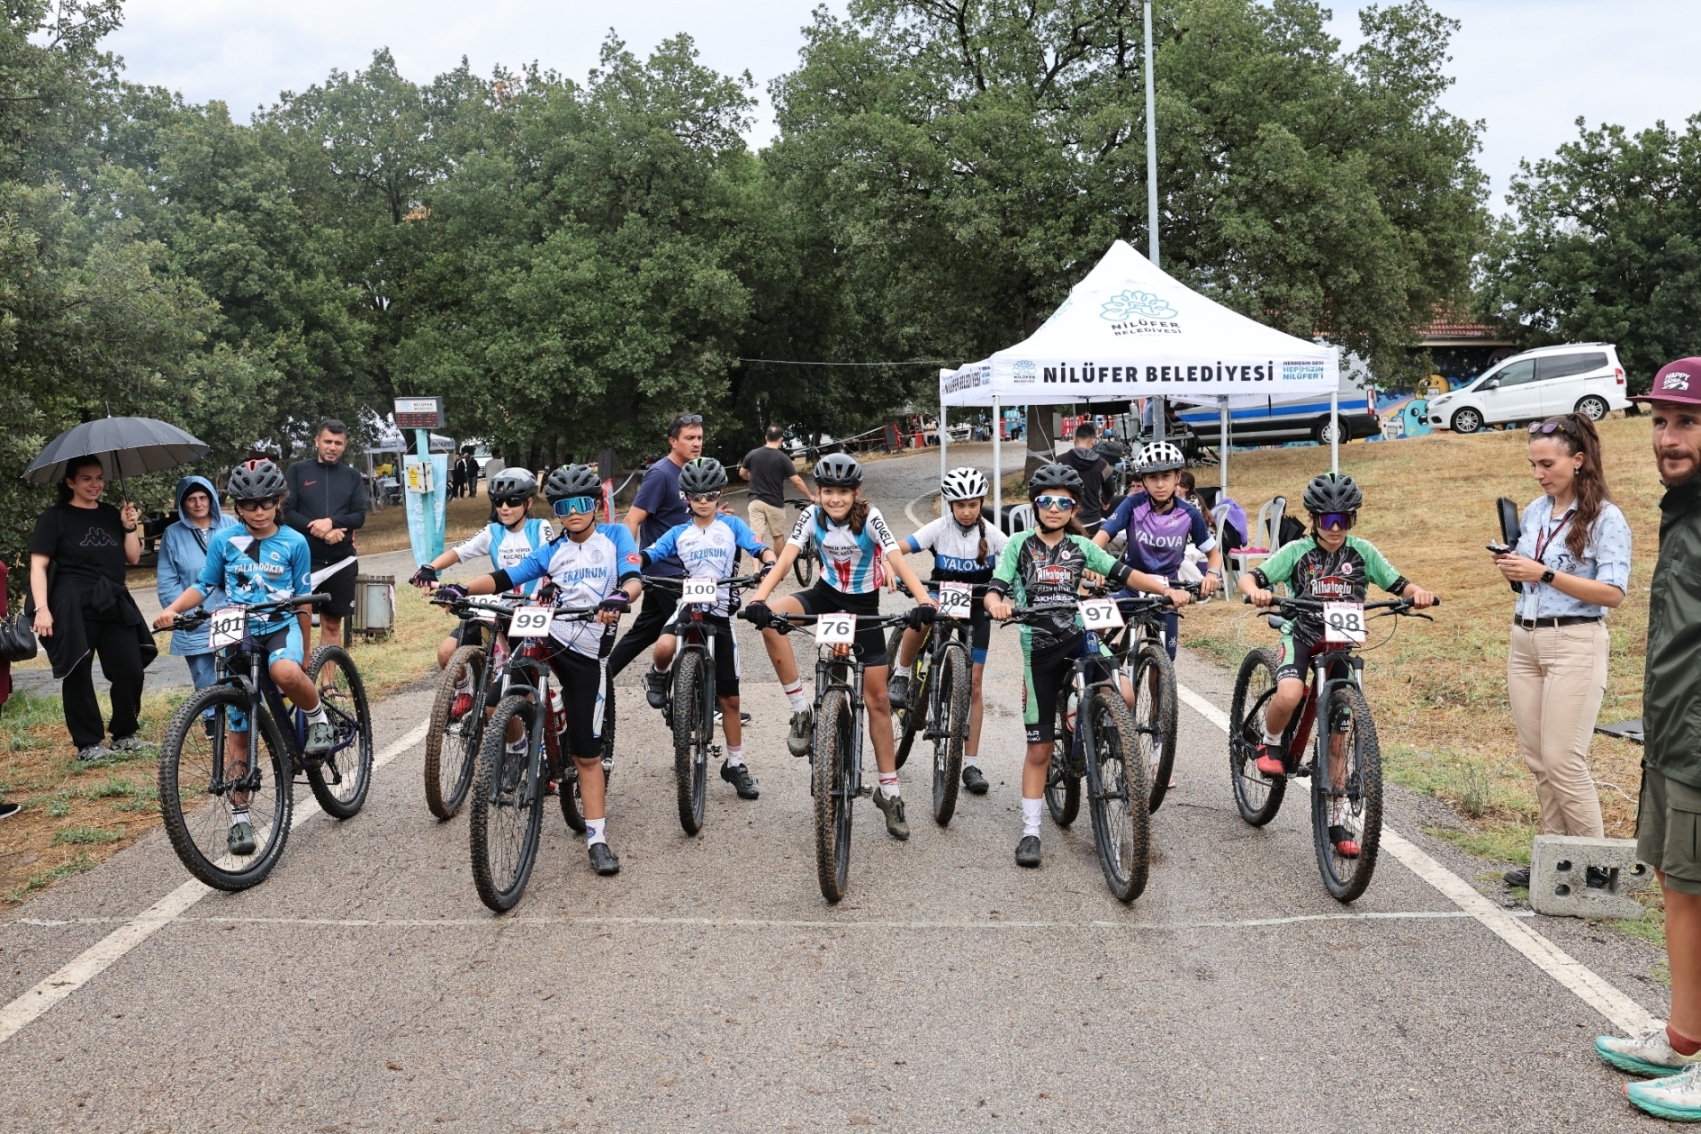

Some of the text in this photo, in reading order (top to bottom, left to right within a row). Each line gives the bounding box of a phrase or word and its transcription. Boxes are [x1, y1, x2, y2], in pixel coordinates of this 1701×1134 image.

[1111, 318, 1180, 330] NİLÜFER
[1114, 327, 1182, 336] BELEDİYESİ
[1043, 360, 1273, 383] NİLÜFER BELEDİYESİ
[1664, 372, 1690, 381] HAPPY
[1135, 529, 1183, 548] YALOVA
[689, 547, 728, 561] ERZURUM
[234, 562, 285, 574] PALANDÖKEN
[942, 556, 990, 571] YALOV
[563, 567, 608, 583] ERZURUM
[685, 585, 715, 595] 100
[940, 591, 970, 608] 102
[1085, 606, 1113, 621] 97
[212, 616, 242, 636] 101
[516, 614, 547, 629] 99
[822, 621, 850, 636] 76
[1329, 612, 1360, 632] 98
